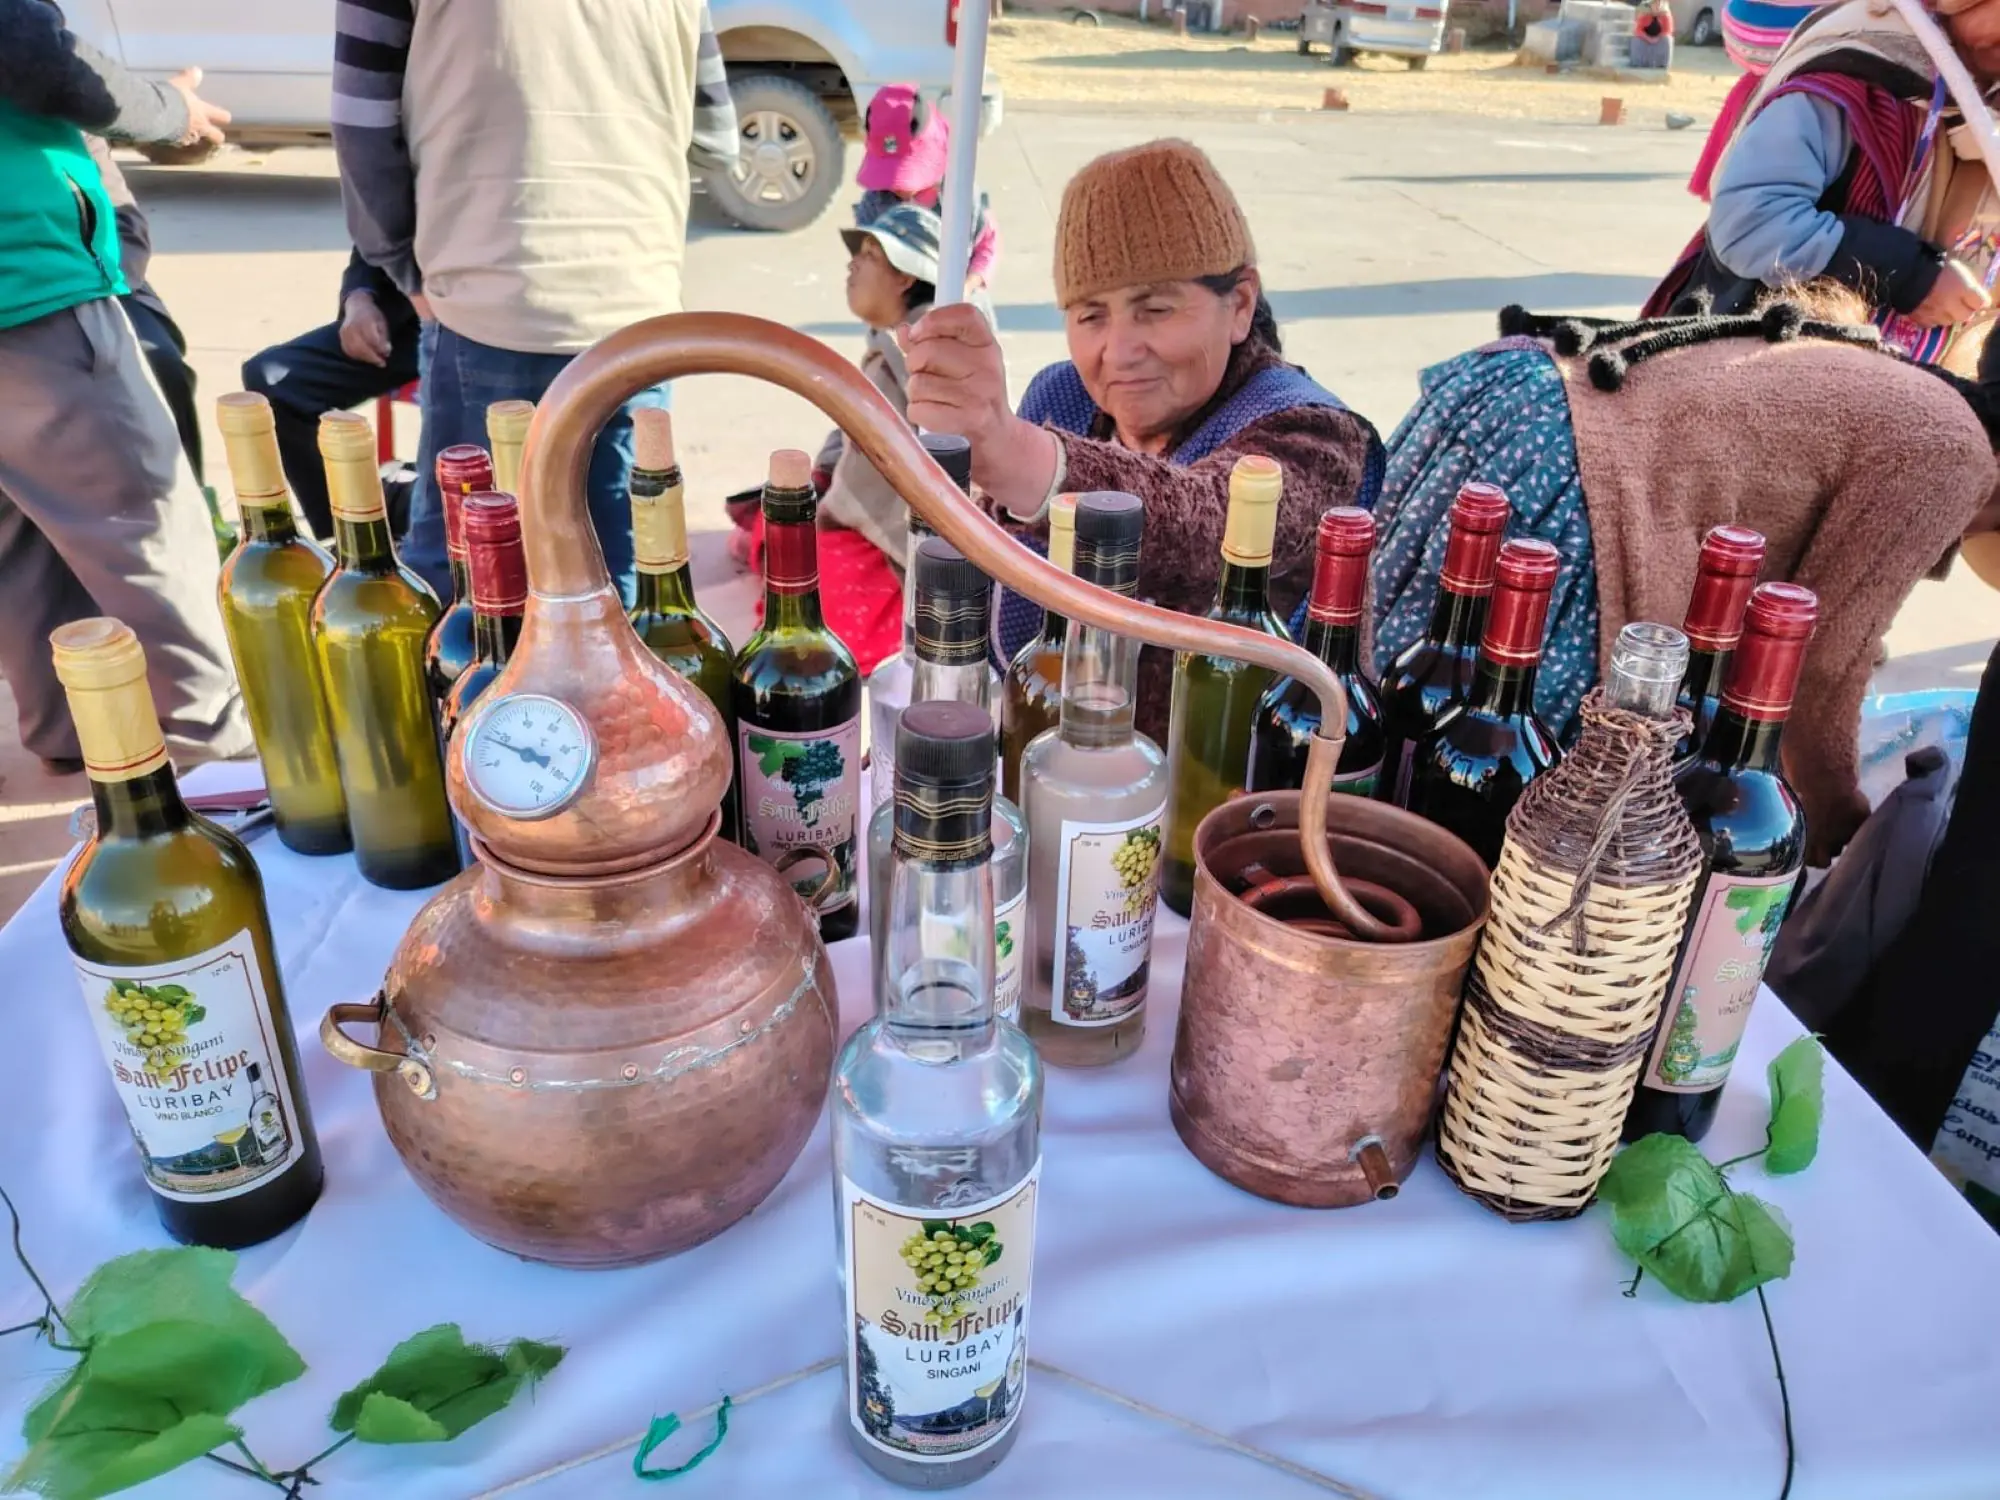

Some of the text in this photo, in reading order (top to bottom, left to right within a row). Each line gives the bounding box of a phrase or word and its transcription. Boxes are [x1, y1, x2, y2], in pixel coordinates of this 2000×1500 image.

[776, 825, 840, 841] LURIBAY
[1091, 910, 1131, 931] San
[113, 1050, 249, 1093] San Felipe
[137, 1083, 233, 1109] LURIBAY
[155, 1105, 223, 1122] VINO BLANCO
[880, 1309, 940, 1343] San
[905, 1331, 1004, 1363] LURIBAY
[927, 1361, 981, 1380] SINGANI
